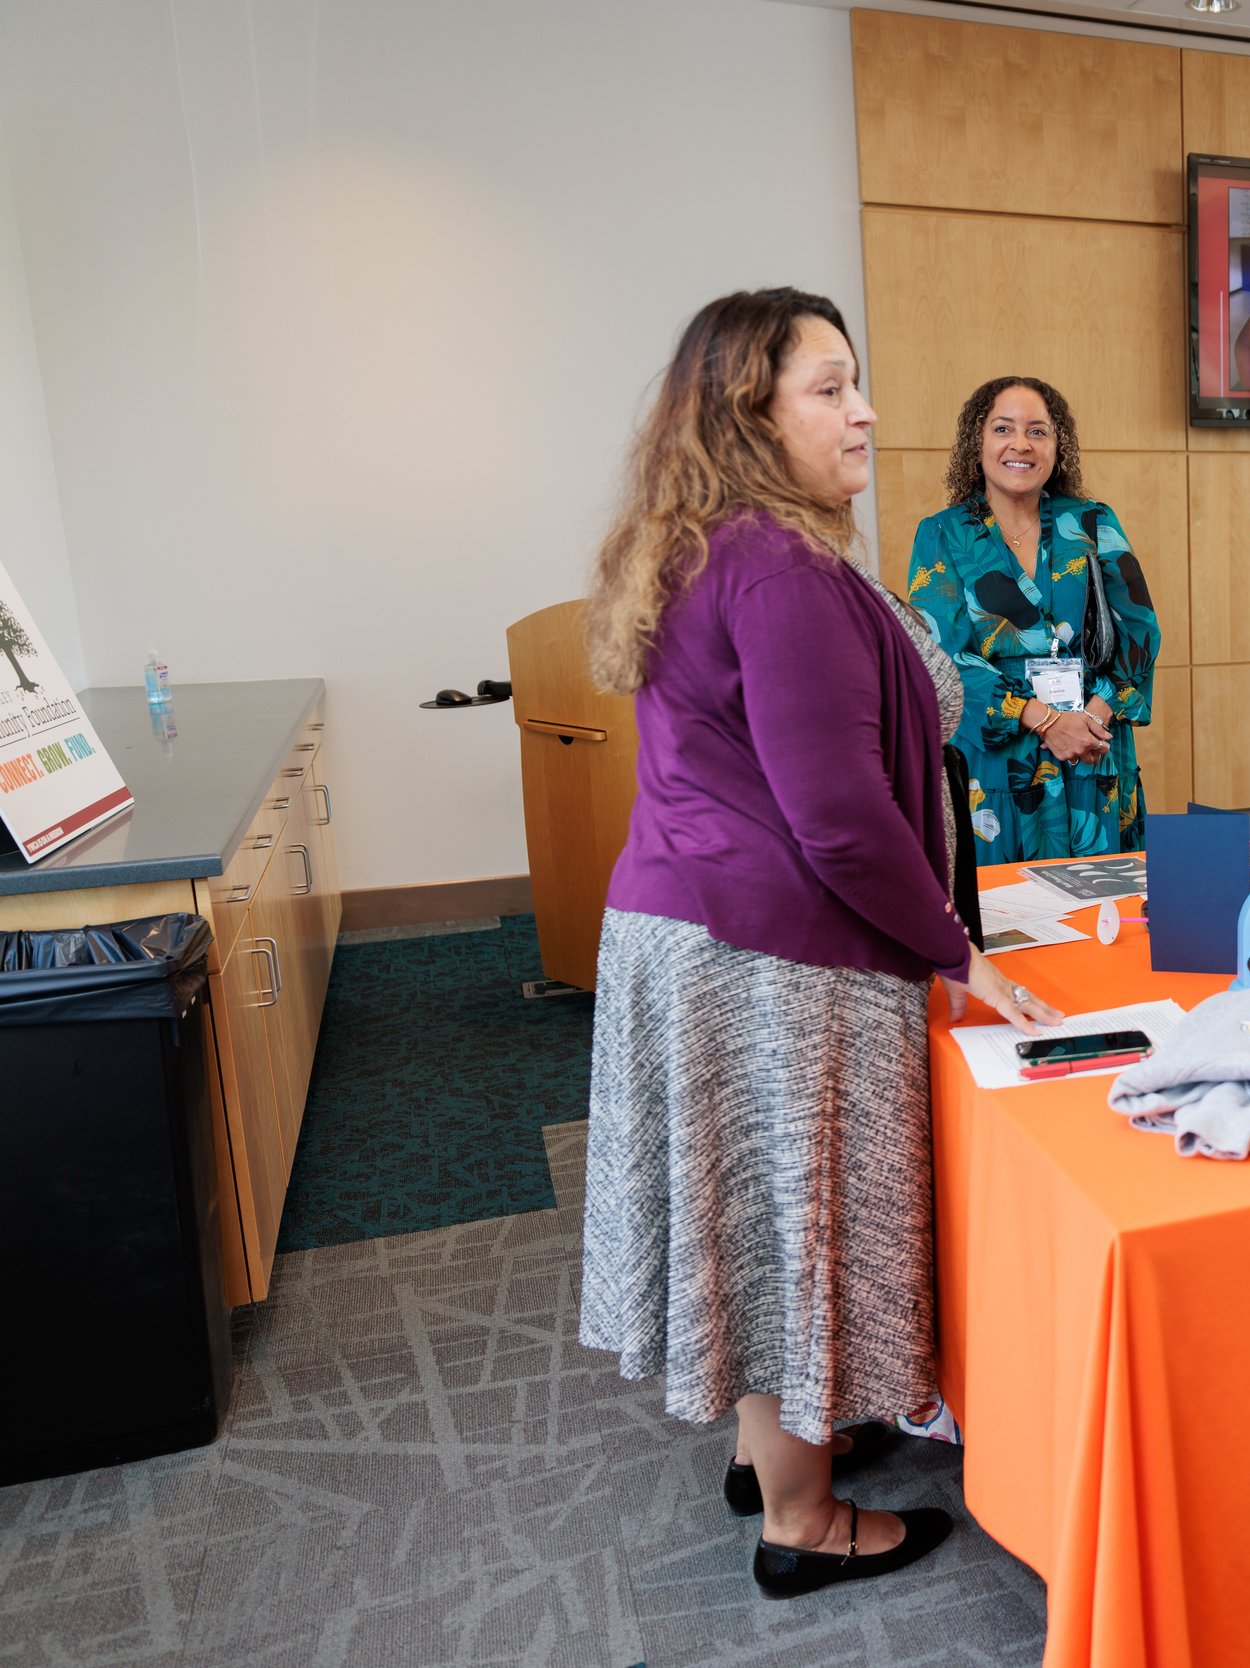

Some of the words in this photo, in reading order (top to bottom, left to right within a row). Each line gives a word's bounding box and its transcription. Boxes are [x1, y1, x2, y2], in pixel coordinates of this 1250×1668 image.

[22, 696, 77, 728] Foundation
[36, 741, 73, 774] GROW.
[64, 732, 97, 762] FUND.
